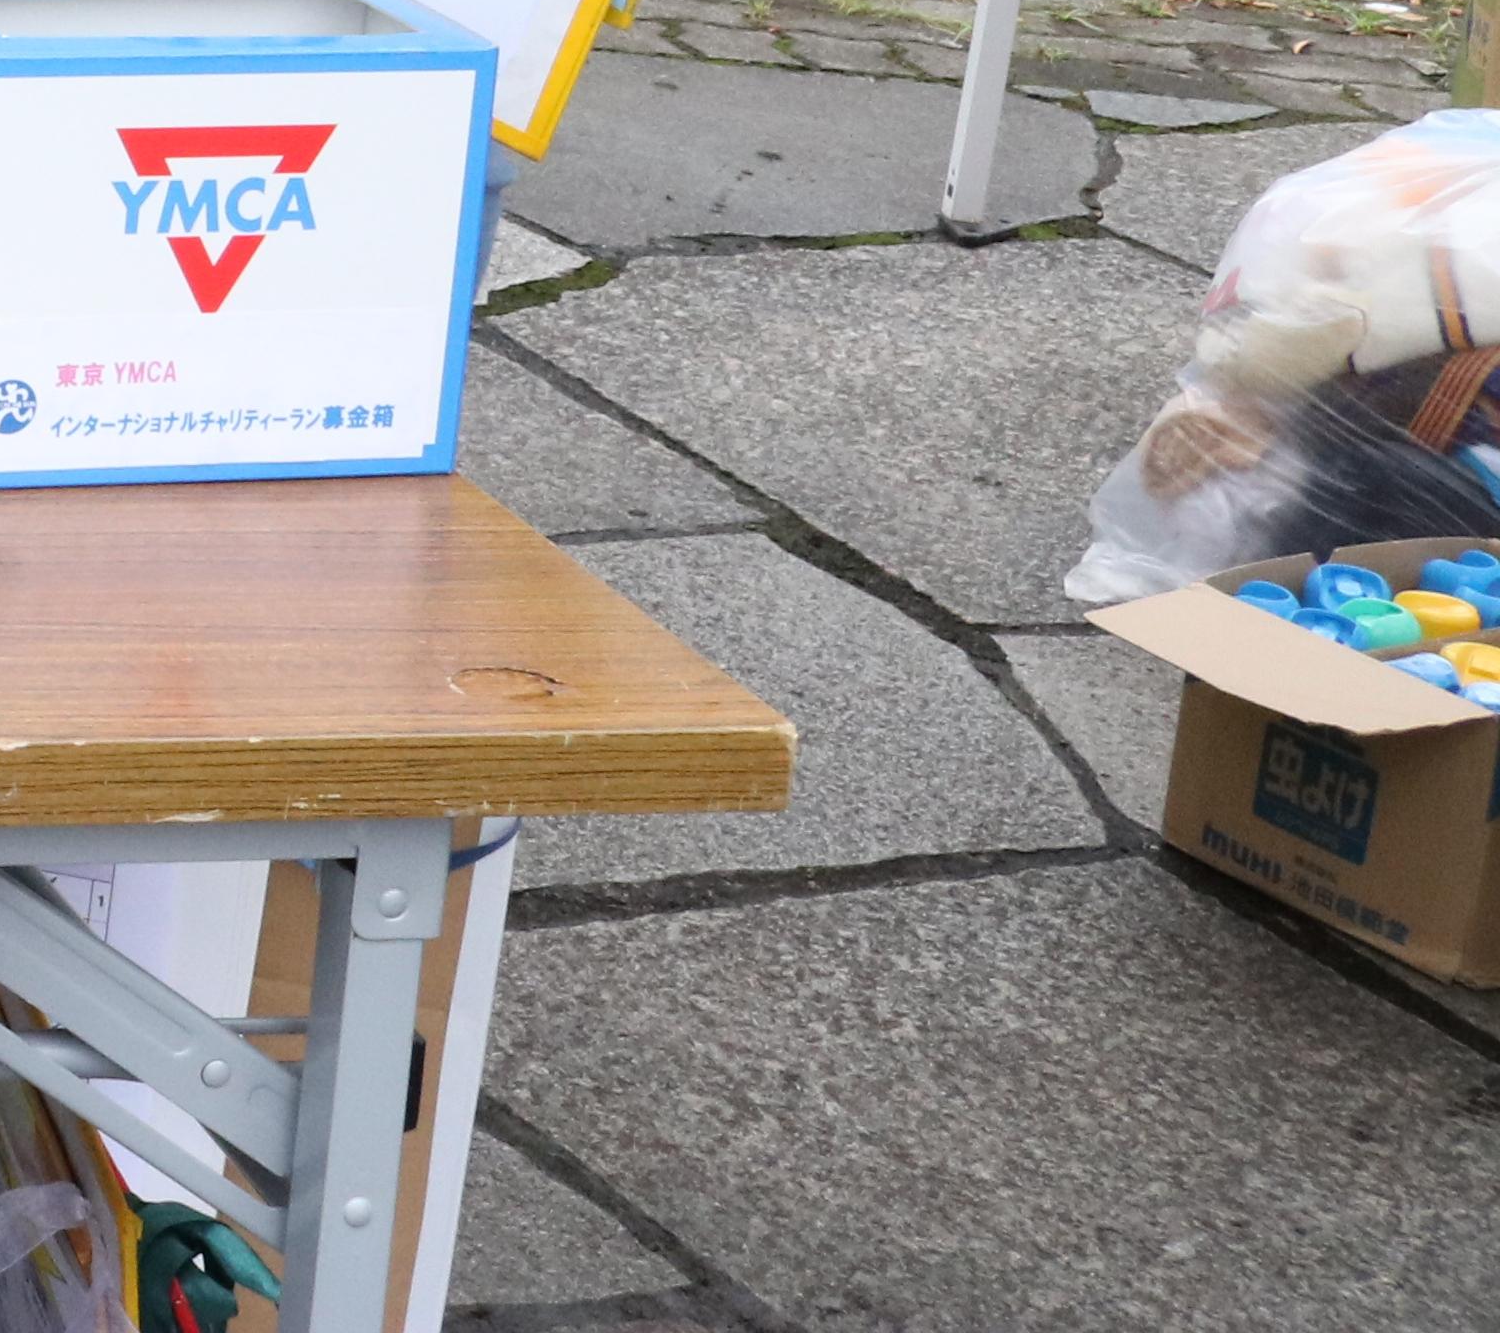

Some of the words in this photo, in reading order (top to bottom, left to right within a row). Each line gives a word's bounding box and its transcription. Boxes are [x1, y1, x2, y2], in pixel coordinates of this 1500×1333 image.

[111, 174, 317, 236] YMCA
[54, 362, 105, 388] 東京
[113, 359, 178, 385] YMCA
